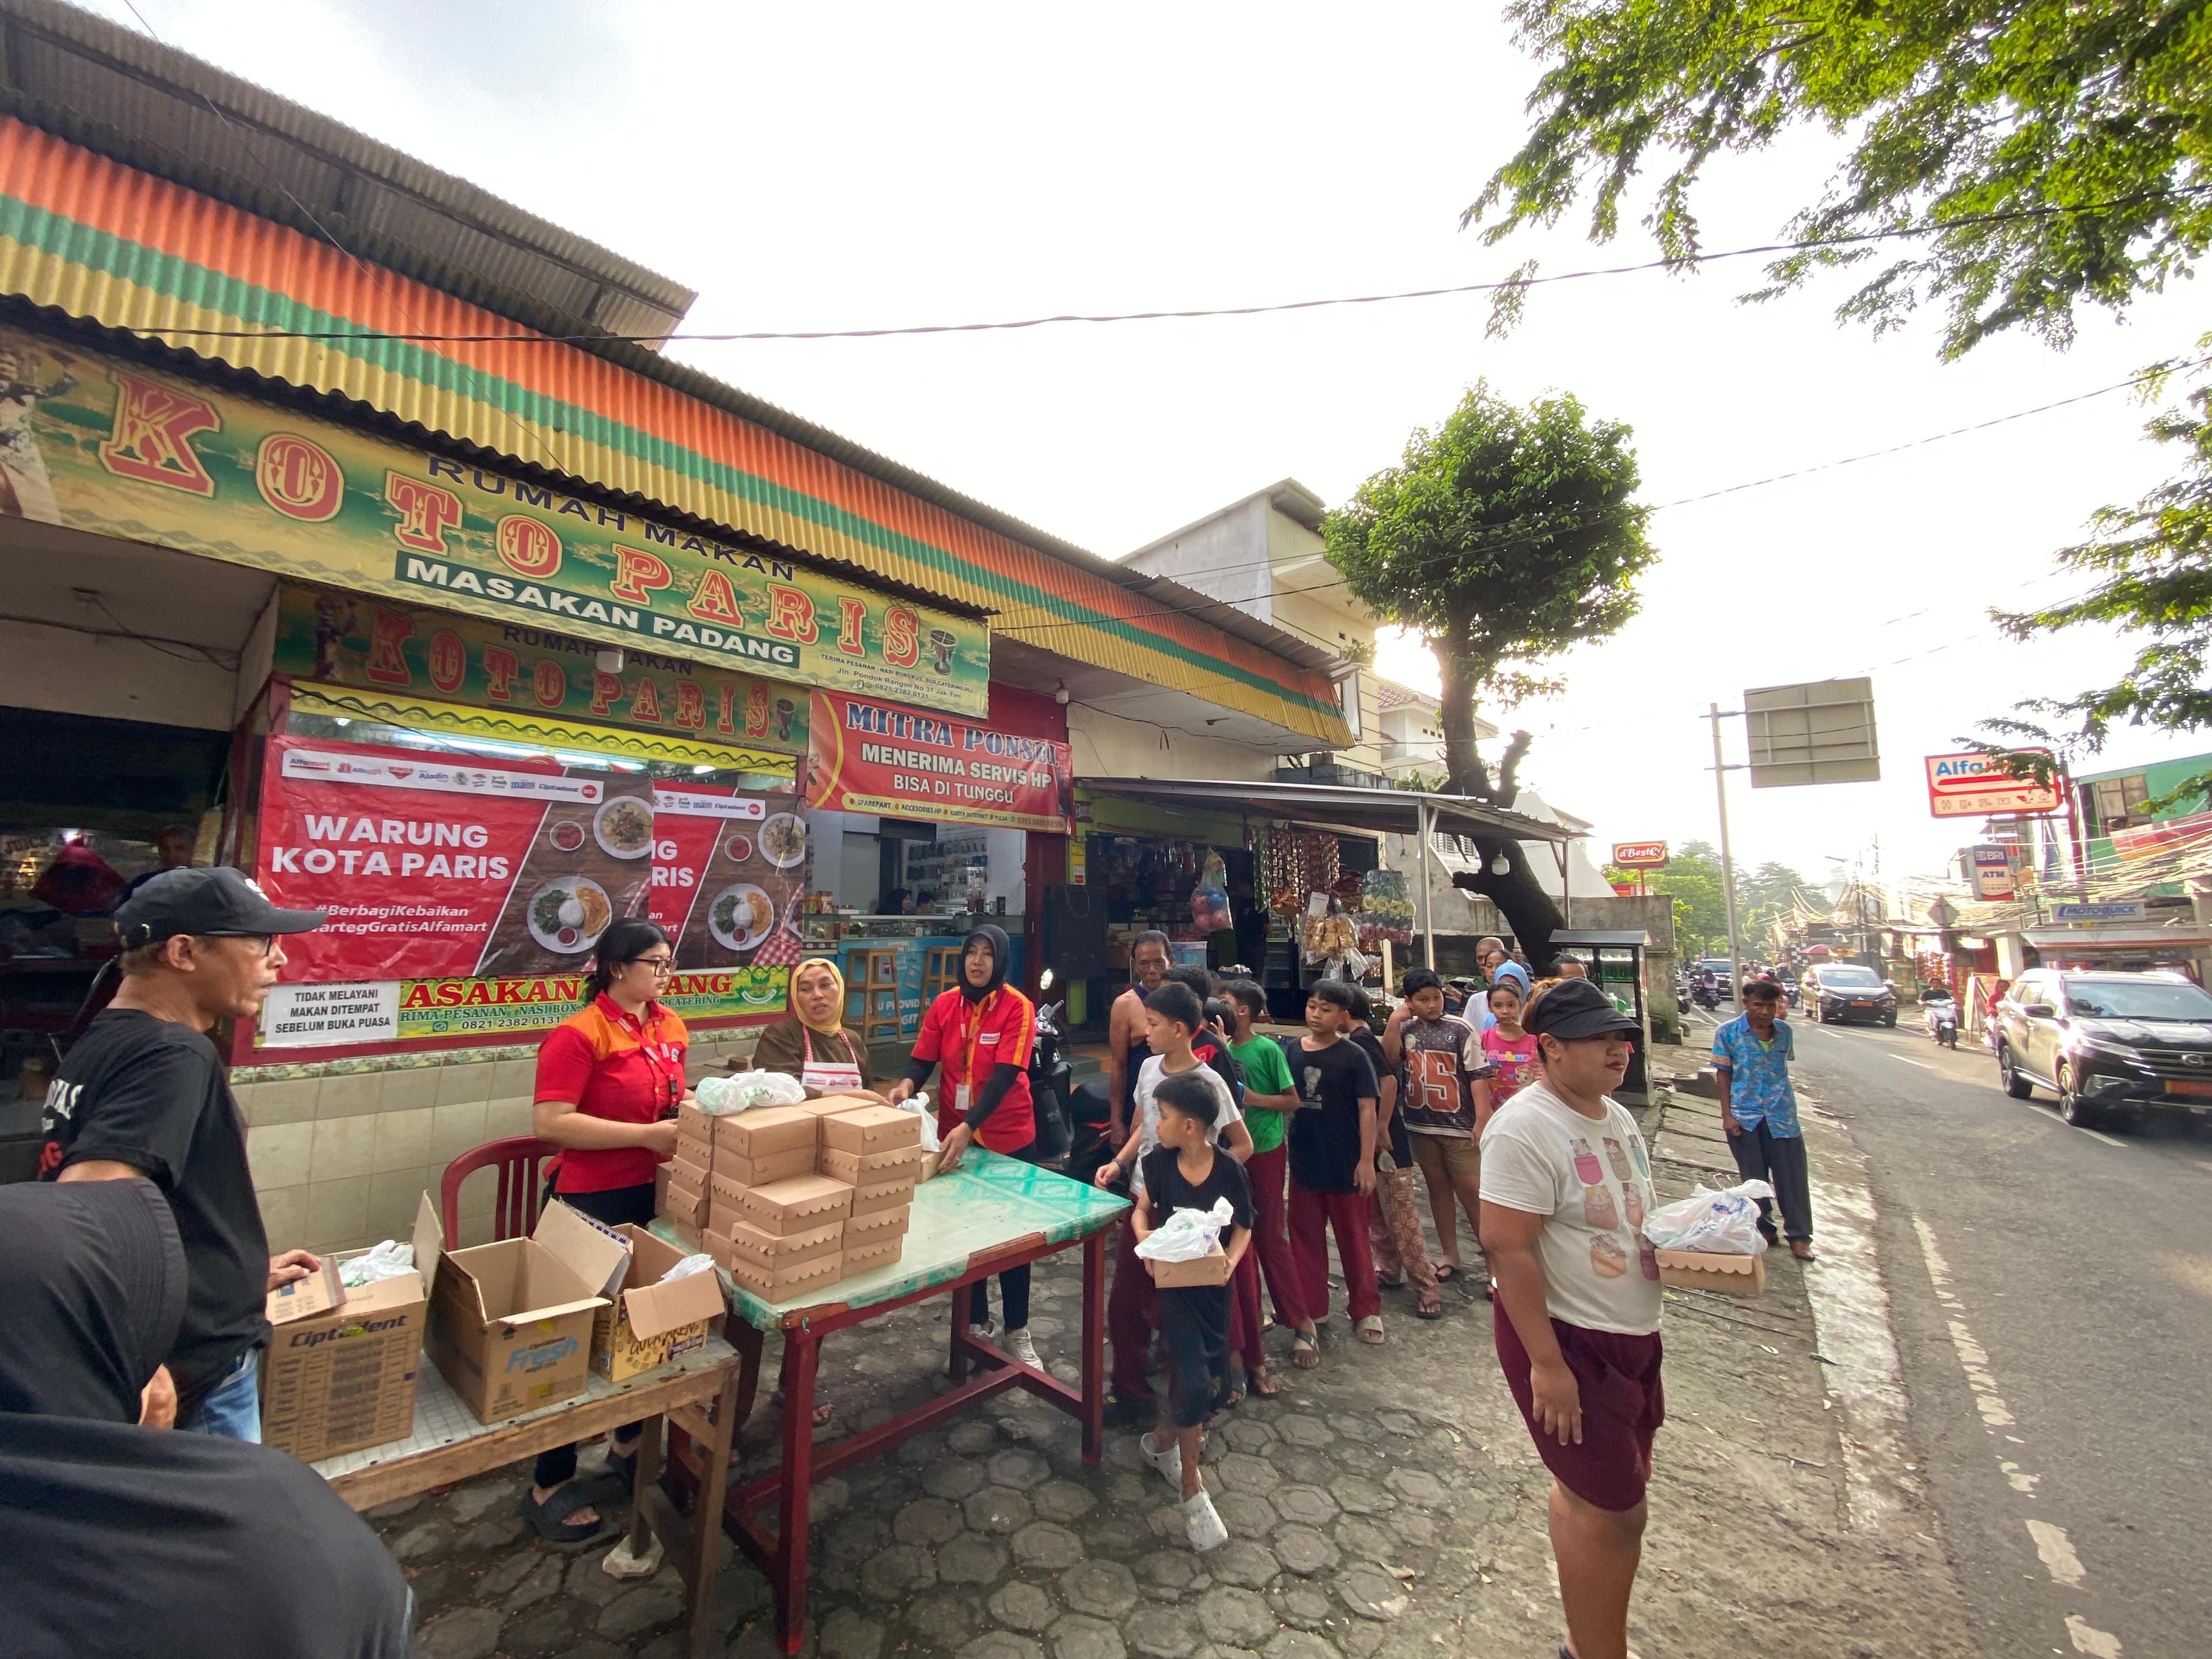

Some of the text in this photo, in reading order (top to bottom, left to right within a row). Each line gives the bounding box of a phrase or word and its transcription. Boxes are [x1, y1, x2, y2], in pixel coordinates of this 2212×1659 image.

[428, 456, 795, 582] RUMAH MAKAN
[407, 557, 794, 664] MASAKAN PADANG
[609, 542, 921, 669] PARIS
[628, 650, 692, 676] AKAN
[821, 654, 846, 665] TERIMA
[847, 659, 876, 671] PESANAN
[854, 670, 883, 683] Pondok
[885, 677, 912, 690] Rangon
[935, 688, 961, 699] Jak-Tim
[590, 670, 771, 739] PARIS
[846, 701, 955, 748] MITRA
[963, 726, 1060, 767] PONSEL
[861, 743, 1052, 789] MENERIMA SERVIS HP
[893, 774, 1014, 804] BISA DI TUNGGU
[857, 798, 892, 809] SPAREPART
[900, 804, 934, 815] ACCESORIES
[303, 814, 488, 849] WARUNG
[271, 846, 509, 880] KOTA PARIS
[1987, 851, 2004, 860] BRI
[652, 866, 694, 887] RIS
[2066, 905, 2137, 915] MOTOQUICK
[311, 922, 488, 935] artegGratisAlfamart
[294, 989, 378, 1002] TIDAK MELAYANI
[400, 978, 582, 1009] ASAKAN
[662, 974, 733, 997] ANG
[290, 1003, 380, 1018] MAKAN DITEMPAT
[400, 1009, 440, 1022] RIMA
[443, 1005, 507, 1020] PESANAN
[518, 1005, 549, 1016] NASI
[461, 1016, 561, 1029] 0821 2382 0131
[275, 1017, 391, 1033] SEBELUM BUKA PUASA
[505, 1336, 579, 1373] Fresh
